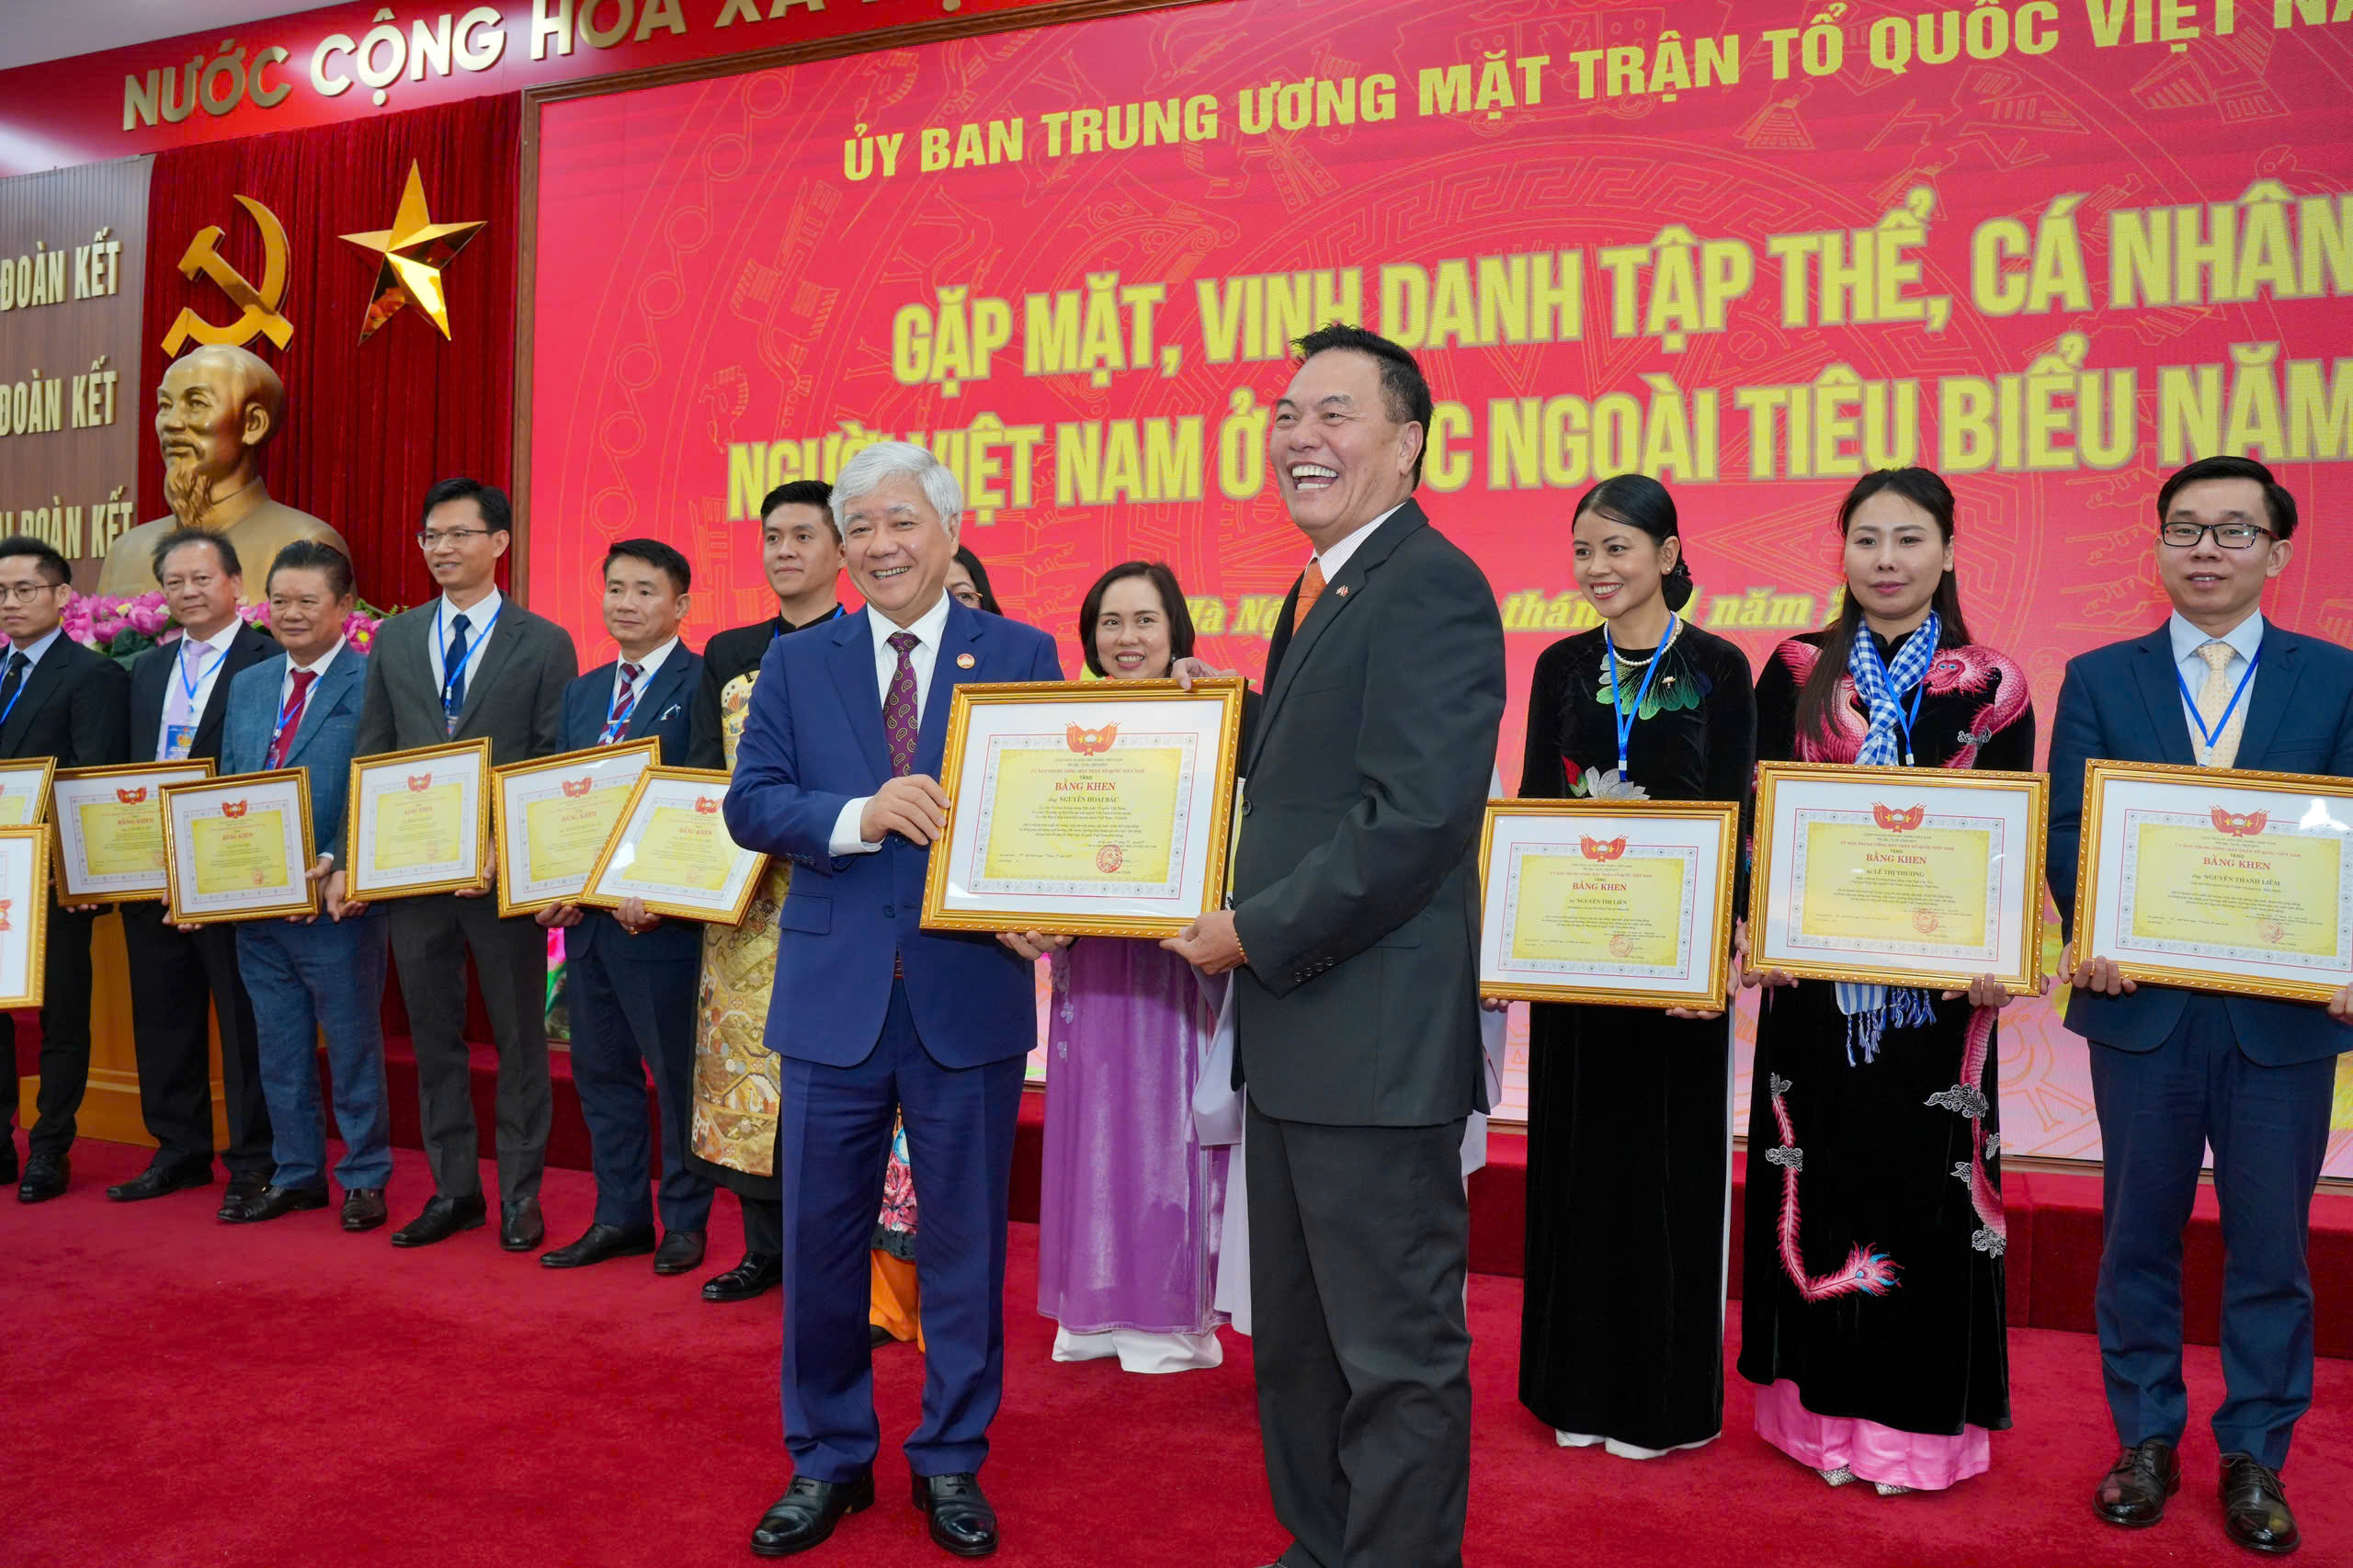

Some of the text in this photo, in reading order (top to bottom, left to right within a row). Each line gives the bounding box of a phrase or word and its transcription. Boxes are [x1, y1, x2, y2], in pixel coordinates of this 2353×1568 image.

[122, 39, 291, 131] NƯỚC
[310, 6, 506, 107] CỘNG
[846, 123, 905, 181] ỦY
[921, 118, 1025, 174] BAN
[1041, 95, 1219, 158] TRUNG
[1240, 74, 1397, 136] ƯƠNG
[1419, 50, 1552, 120] MẶT
[1570, 32, 1741, 106] TRẬN
[1763, 2, 1847, 81] TỔ
[0, 227, 120, 311] ĐOÀN KẾT
[892, 181, 2353, 399] GẶP MẶT, VINH DANH TẬP THỂ, CÁ NHÂN
[72, 355, 118, 428] KẾT
[1490, 374, 1719, 491] NGOÀI
[1735, 364, 1918, 481] TIÊU
[1939, 333, 2136, 473] BIỂU
[2160, 343, 2353, 467] NĂM
[1056, 416, 1207, 507] NAM
[1218, 387, 1270, 500] Ở
[1500, 588, 1605, 631] thán
[1707, 588, 1812, 628] năm
[1086, 782, 1116, 791] KHEN
[1600, 883, 1627, 892] KHEN
[1897, 855, 1927, 864] KHEN
[2239, 859, 2271, 870] KHEN
